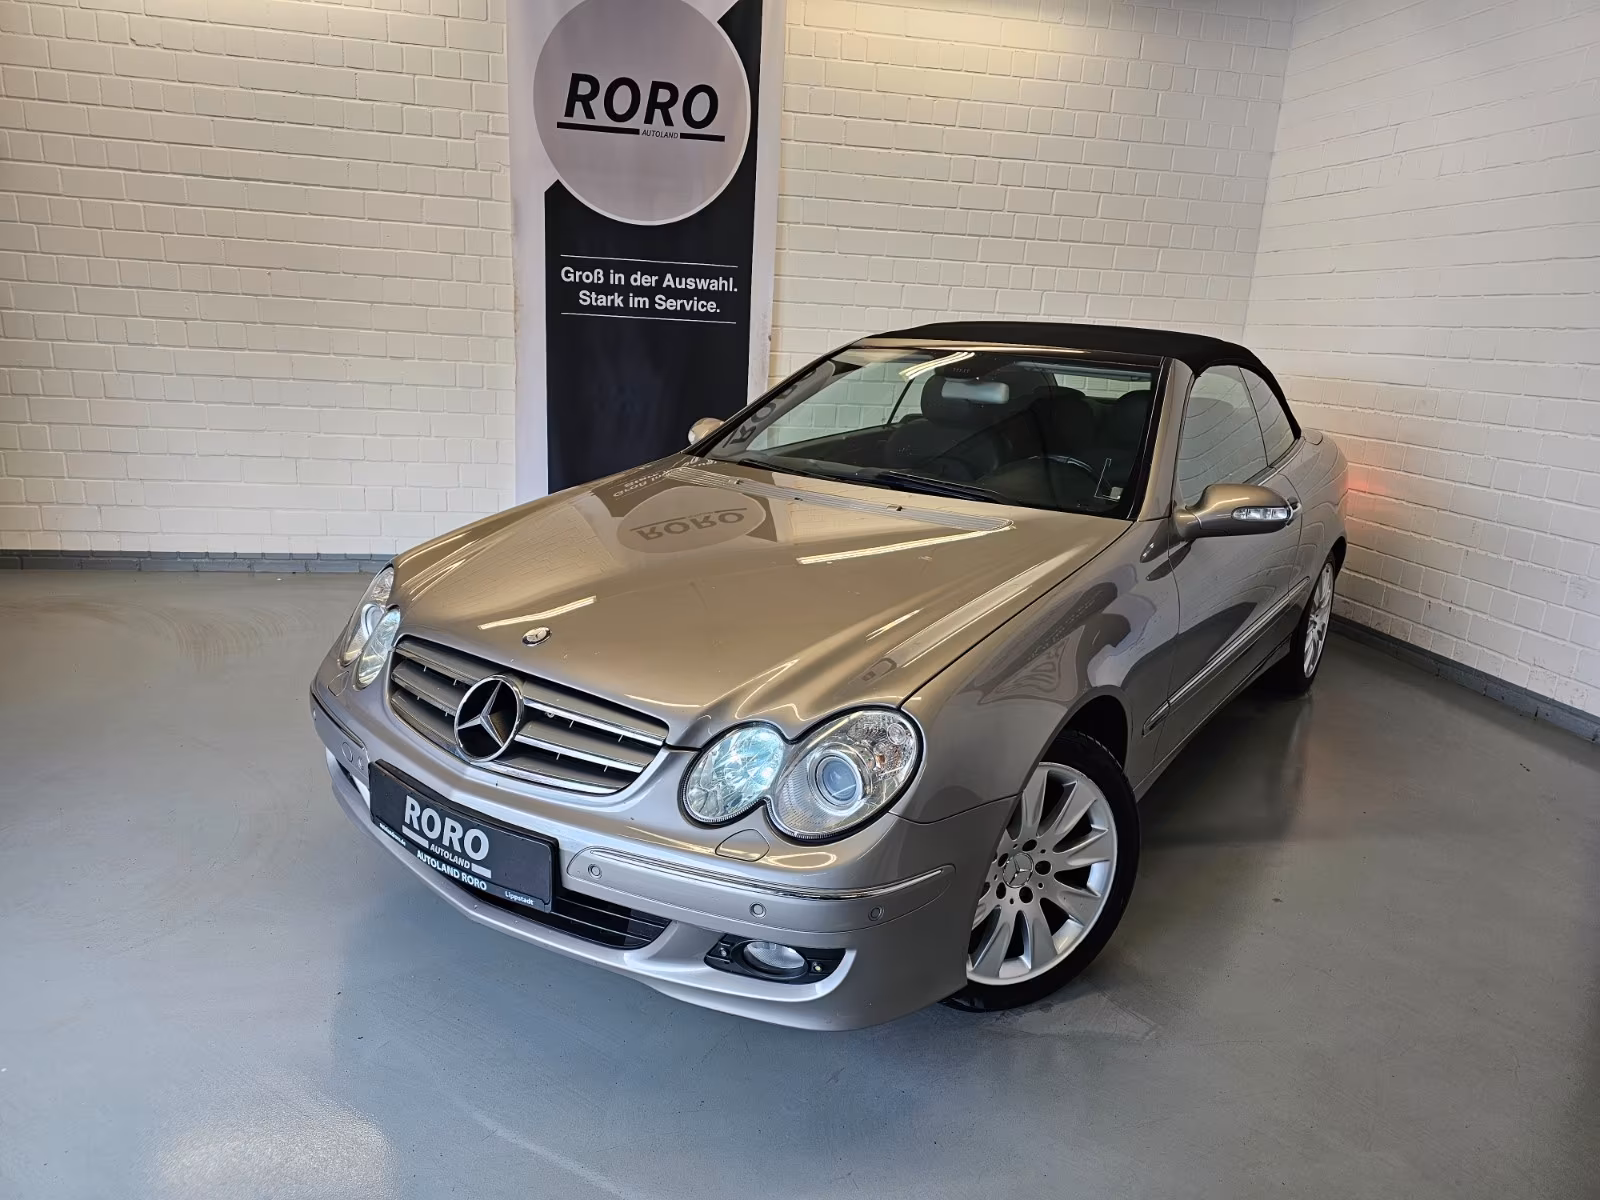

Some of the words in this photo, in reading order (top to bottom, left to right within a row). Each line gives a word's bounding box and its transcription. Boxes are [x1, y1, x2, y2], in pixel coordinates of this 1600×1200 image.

[564, 73, 718, 129] RORO
[641, 129, 679, 140] AUTOLAND
[560, 266, 605, 284] Groß
[609, 269, 625, 285] in
[630, 271, 659, 287] der
[662, 273, 738, 292] Auswahl.
[578, 290, 624, 307] Stark
[629, 293, 649, 309] im
[654, 294, 721, 313] Service.
[404, 795, 489, 861] RORO
[430, 844, 470, 869] AUTOLAND
[417, 850, 460, 878] AUTOLAND
[461, 872, 487, 891] RORO
